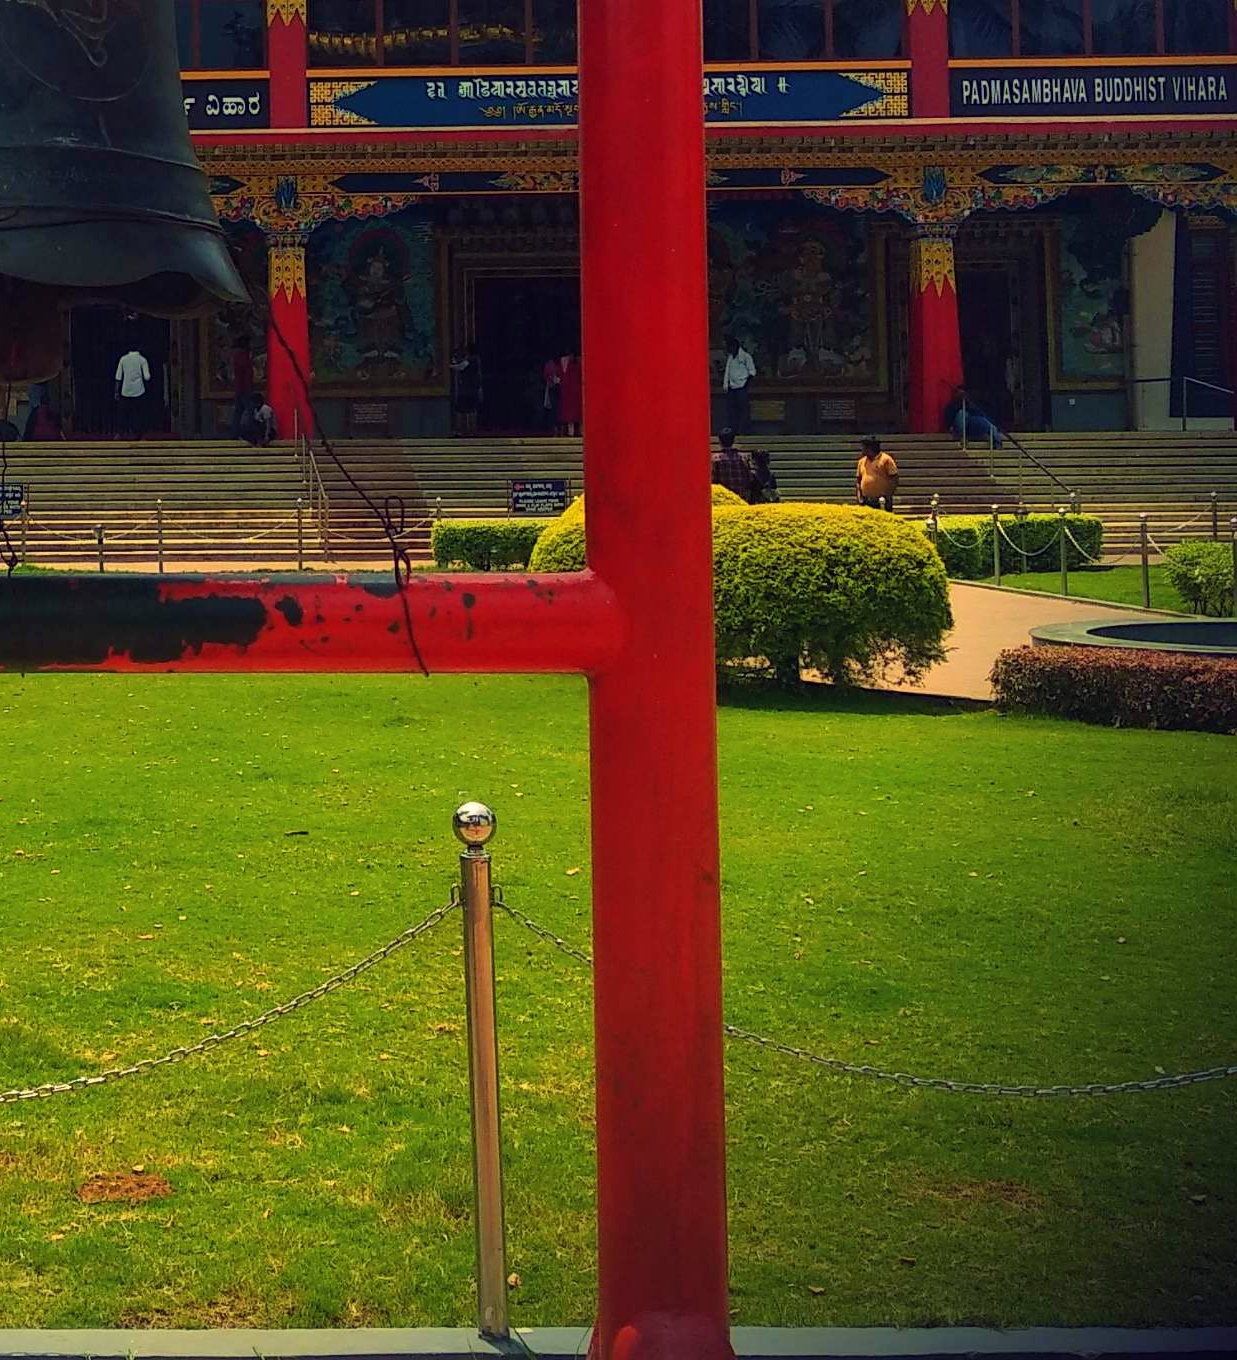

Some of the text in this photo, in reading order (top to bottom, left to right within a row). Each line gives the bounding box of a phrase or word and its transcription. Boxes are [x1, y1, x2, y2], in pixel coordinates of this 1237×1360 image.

[205, 91, 260, 116] ವಿಹಾರ
[962, 75, 1228, 105] PADMASAMBHAVA BUDDHIST VIHARA
